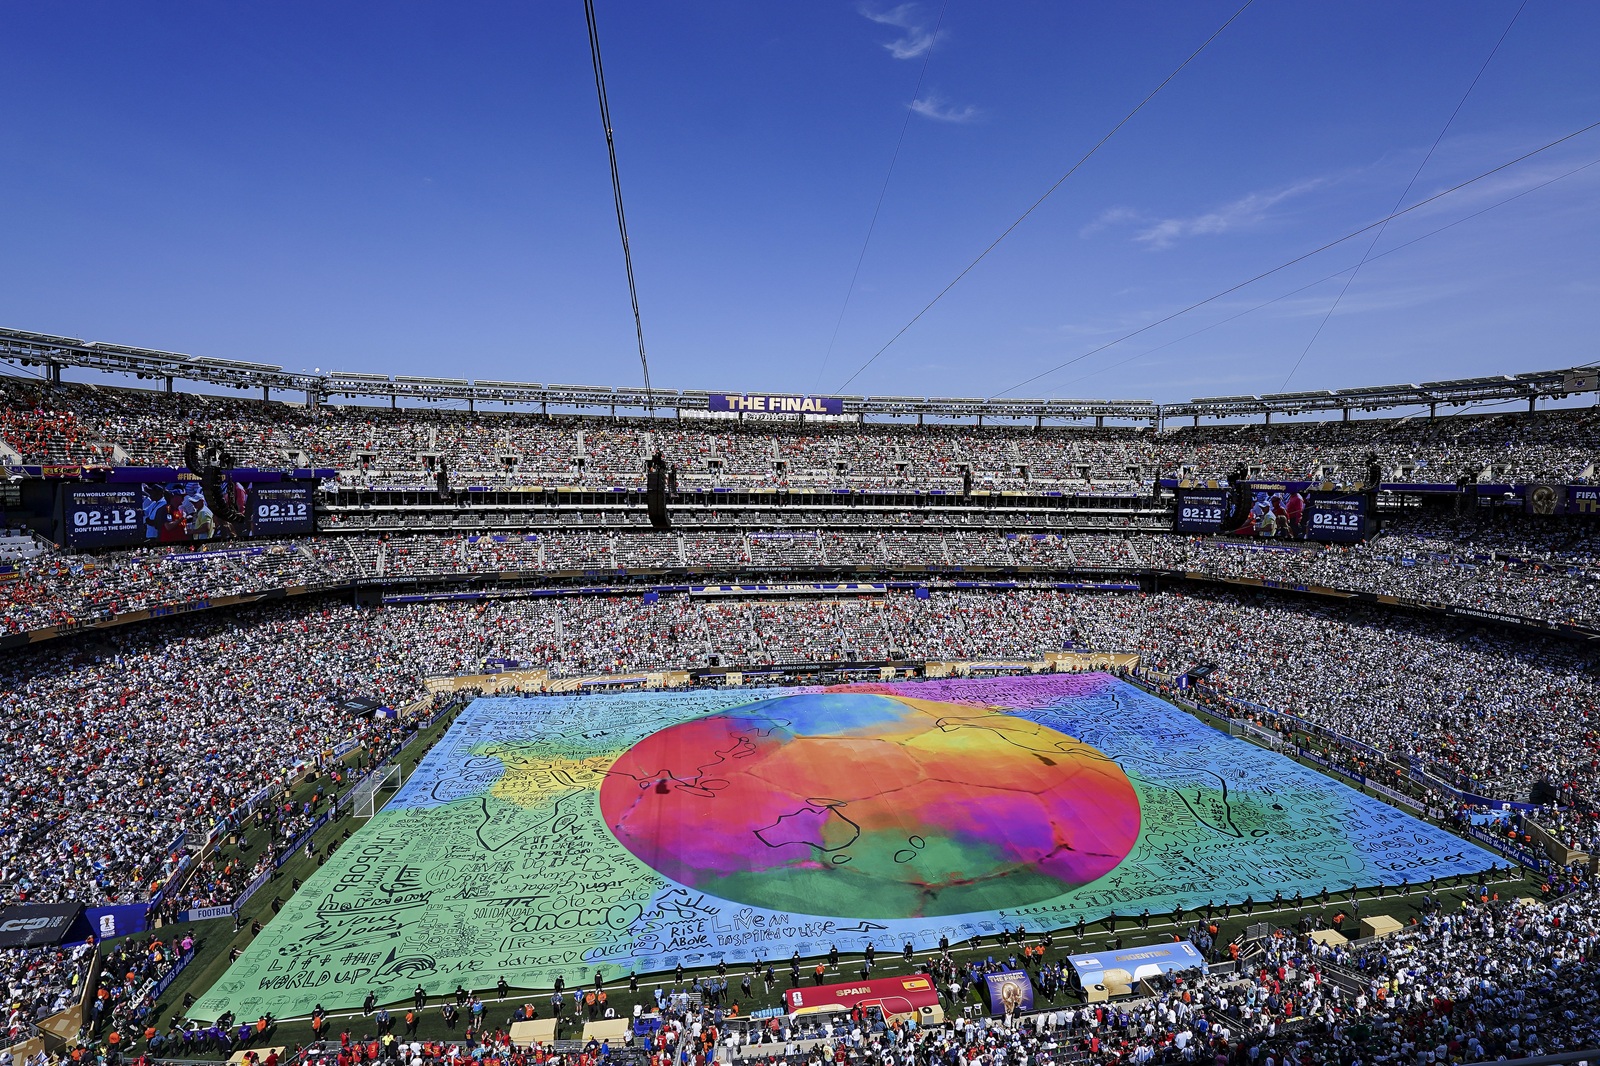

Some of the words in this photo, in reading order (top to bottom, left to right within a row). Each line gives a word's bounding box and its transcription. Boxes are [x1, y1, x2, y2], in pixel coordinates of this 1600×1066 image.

[726, 396, 764, 410] THE
[768, 397, 827, 412] FINAL
[258, 504, 306, 517] 02:12
[1183, 508, 1221, 518] 02:12
[1575, 500, 1600, 512] TH
[74, 510, 136, 526] 02:12
[1313, 514, 1358, 526] 02:12
[150, 607, 174, 617] THE
[176, 601, 211, 613] FINAL
[1467, 610, 1488, 618] WORLD
[1488, 612, 1500, 620] CUP
[1500, 615, 1521, 624] 2026
[1371, 781, 1390, 796] FOOTBALL
[1390, 791, 1405, 803] UNITES
[1475, 831, 1492, 843] UNITES
[1493, 840, 1502, 849] the
[1503, 844, 1520, 859] World
[1522, 856, 1534, 865] FIFA
[197, 907, 234, 918] FOOTBAL
[472, 908, 535, 919] SOLIDARIDAD
[580, 942, 646, 961] COLECTIVO
[1116, 950, 1172, 961] ARGENTINA
[160, 969, 175, 992] UNITES
[258, 970, 331, 990] WORLD
[334, 968, 371, 984] UP
[835, 986, 871, 997] SPAIN
